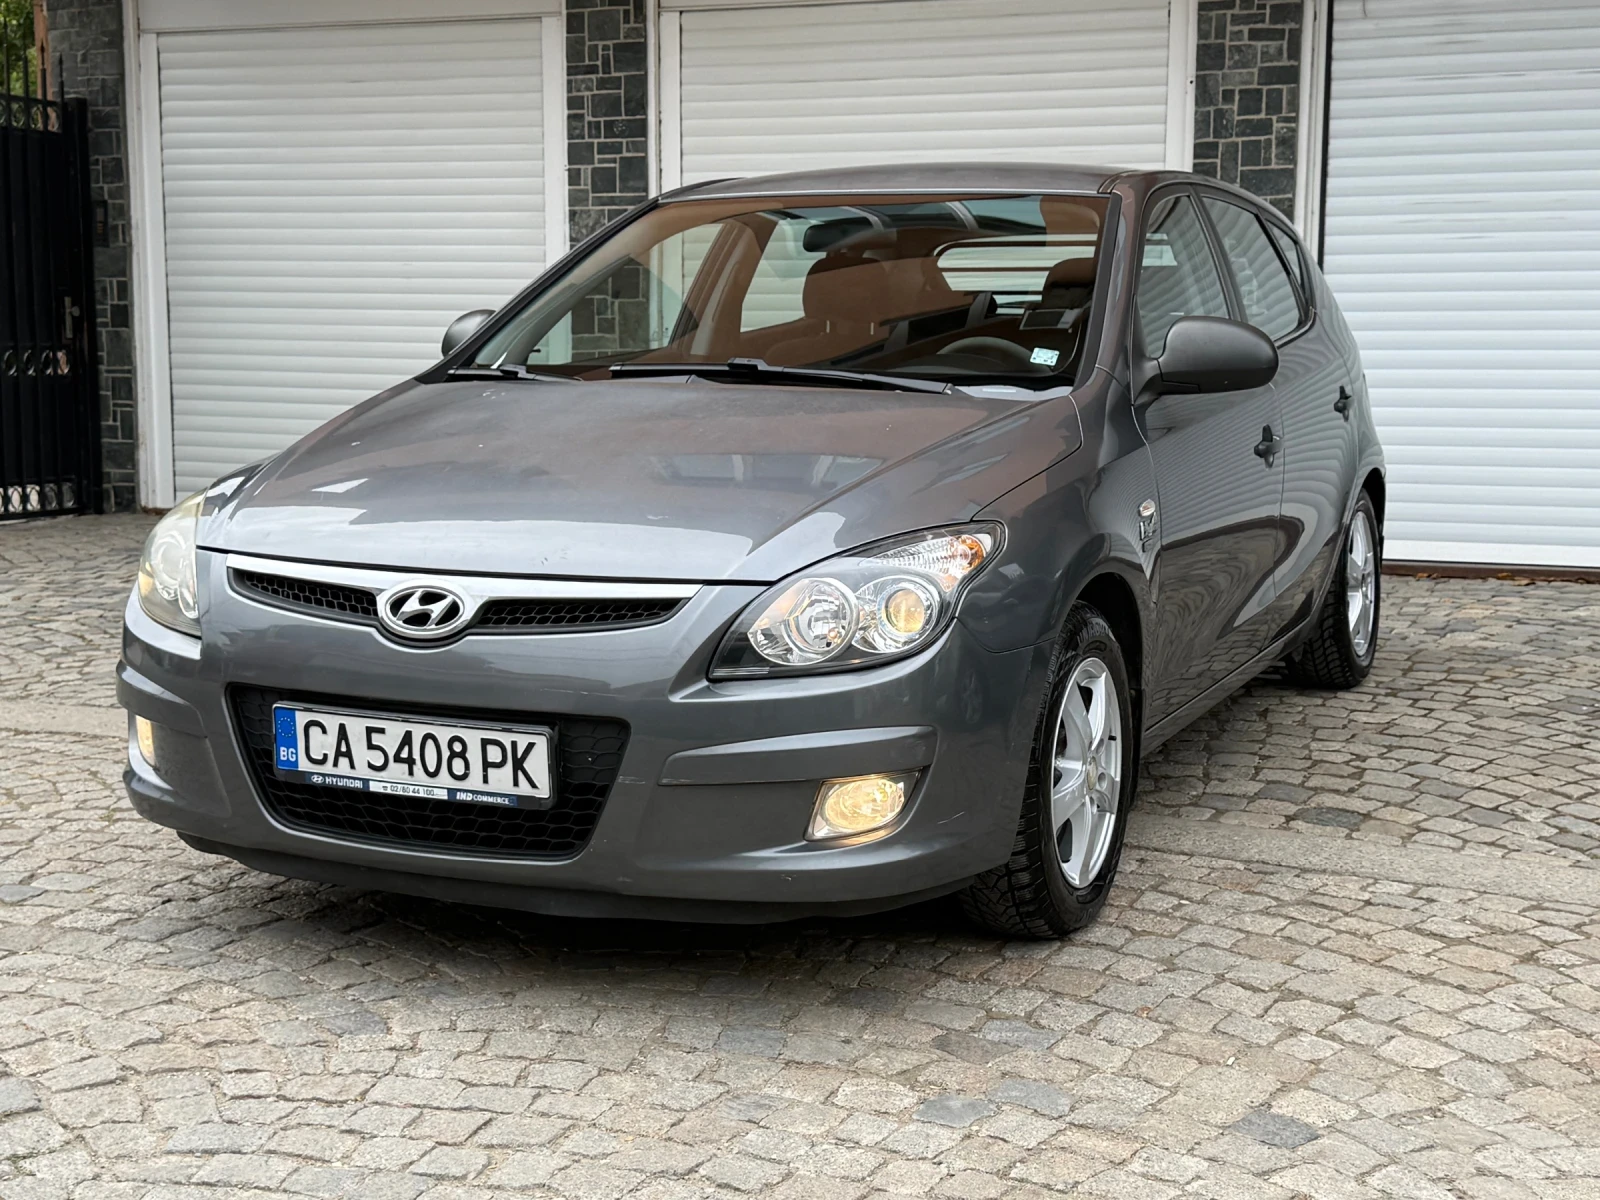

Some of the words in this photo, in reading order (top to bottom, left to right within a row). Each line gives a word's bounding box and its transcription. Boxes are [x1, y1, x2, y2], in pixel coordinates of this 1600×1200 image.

[280, 746, 297, 762] BG
[303, 720, 356, 770] CA
[365, 726, 470, 781] 5408
[480, 737, 540, 789] PK
[325, 776, 363, 789] HYUNDAI
